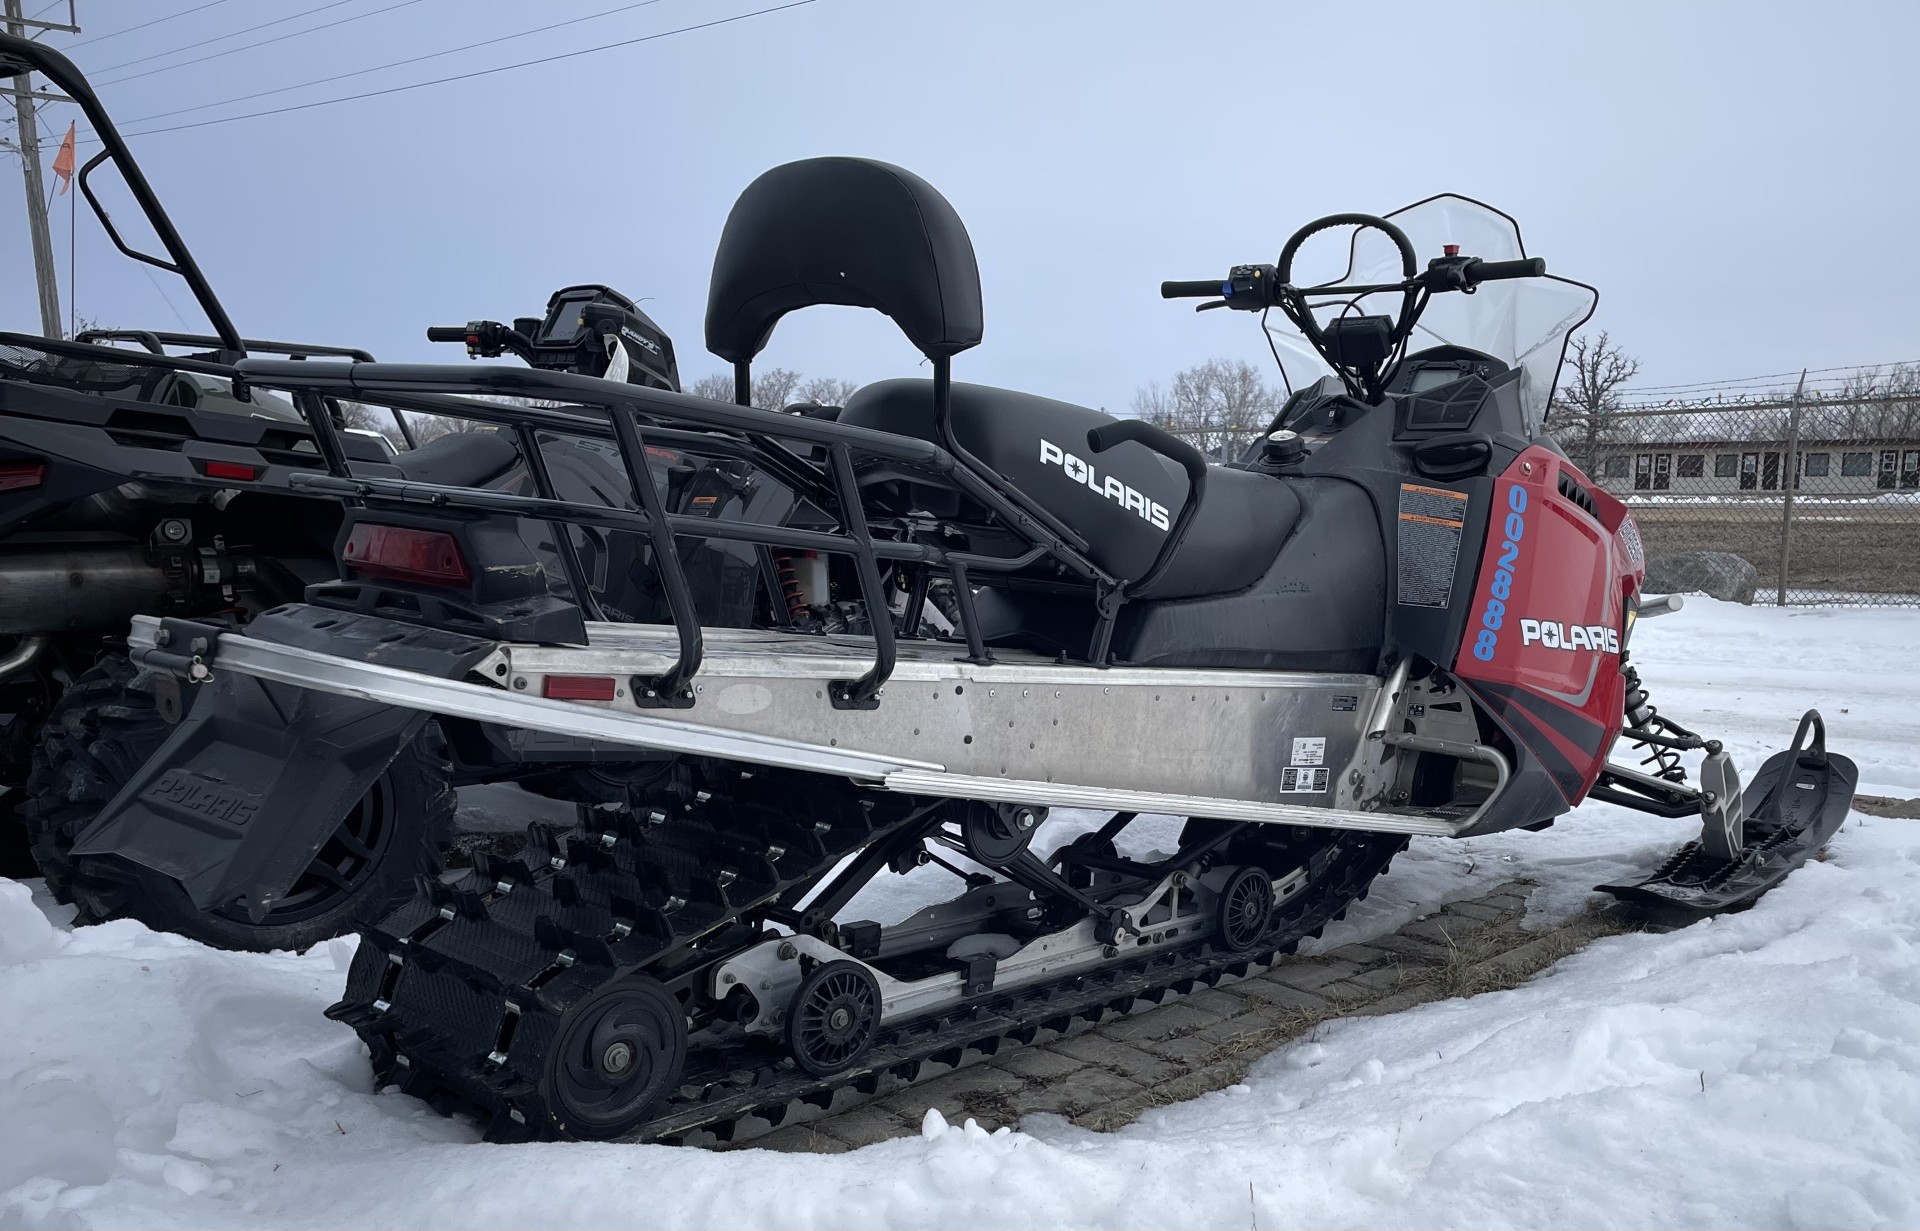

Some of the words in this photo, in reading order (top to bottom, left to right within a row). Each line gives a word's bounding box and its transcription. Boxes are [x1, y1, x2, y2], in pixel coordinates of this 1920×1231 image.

[1039, 438, 1170, 532] POLARIS
[1473, 484, 1528, 662] 002888
[1519, 617, 1620, 655] POLARIS
[150, 777, 260, 827] POLARIS
